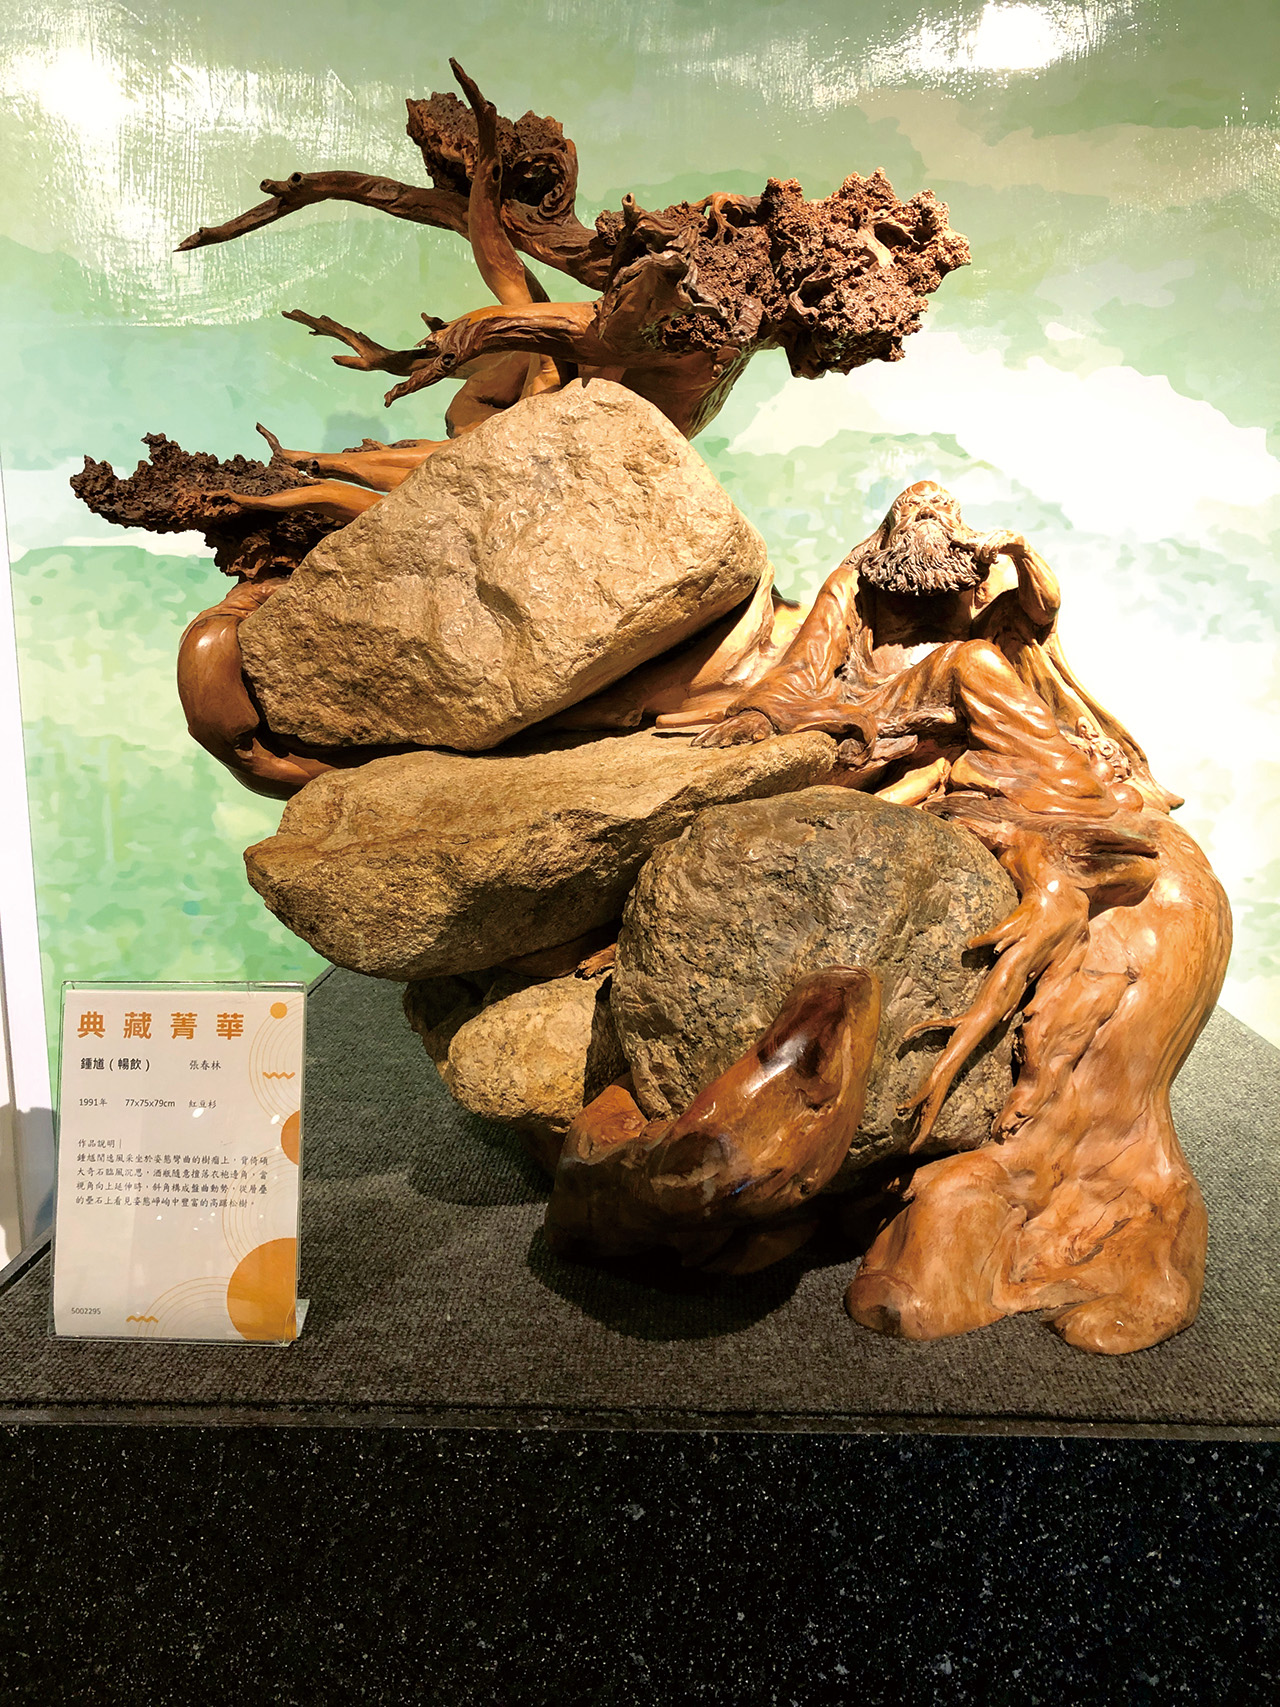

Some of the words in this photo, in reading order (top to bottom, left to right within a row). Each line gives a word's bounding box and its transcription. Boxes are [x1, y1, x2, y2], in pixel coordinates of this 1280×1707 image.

[77, 1010, 245, 1041] 典藏菁華
[189, 1059, 222, 1071] 張春林
[79, 1098, 108, 1107] 1991年
[125, 1098, 176, 1108] 77x75x79cm
[188, 1099, 217, 1109] 紅豆杉
